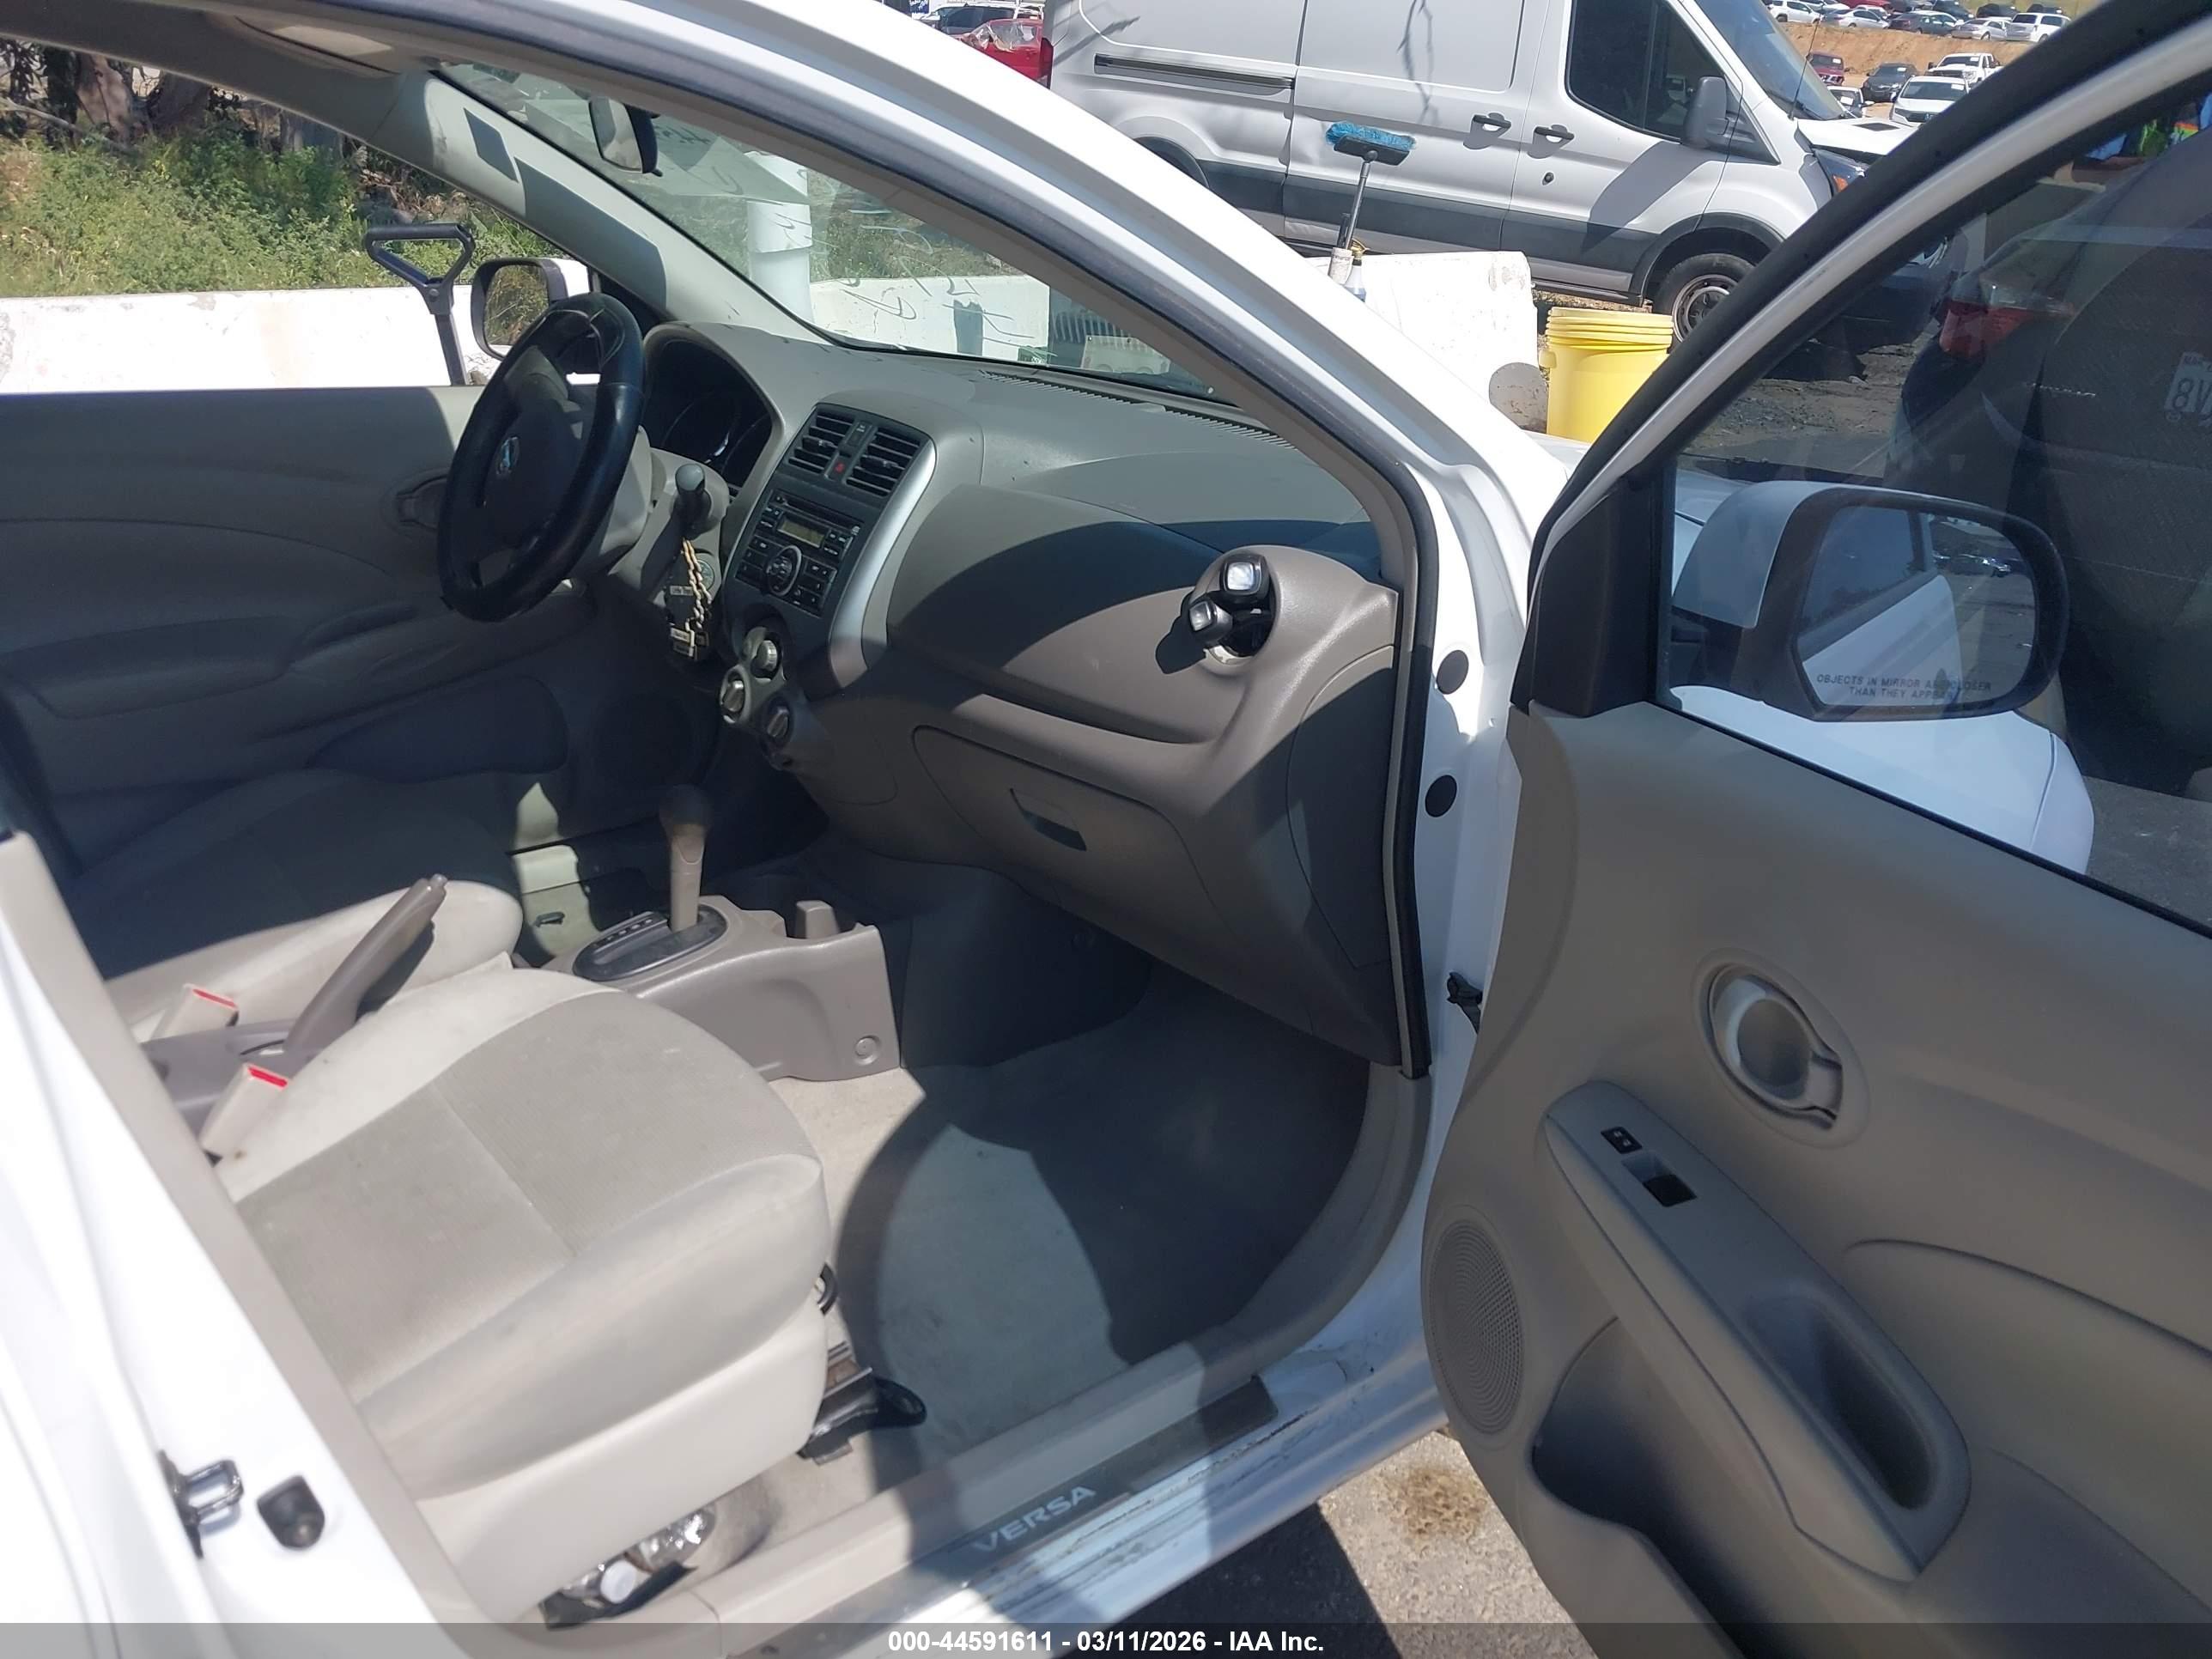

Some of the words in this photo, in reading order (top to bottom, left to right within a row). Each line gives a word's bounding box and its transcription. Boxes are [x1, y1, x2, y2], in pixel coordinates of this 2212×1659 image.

[2172, 378, 2212, 412] 8V
[1816, 674, 1864, 685] OBJECTS
[1867, 677, 1878, 686] IN
[1881, 678, 1920, 688] MIRROR
[1850, 686, 1876, 697] THAN
[1881, 687, 1906, 698] THEY
[972, 1486, 1097, 1552] VERSA
